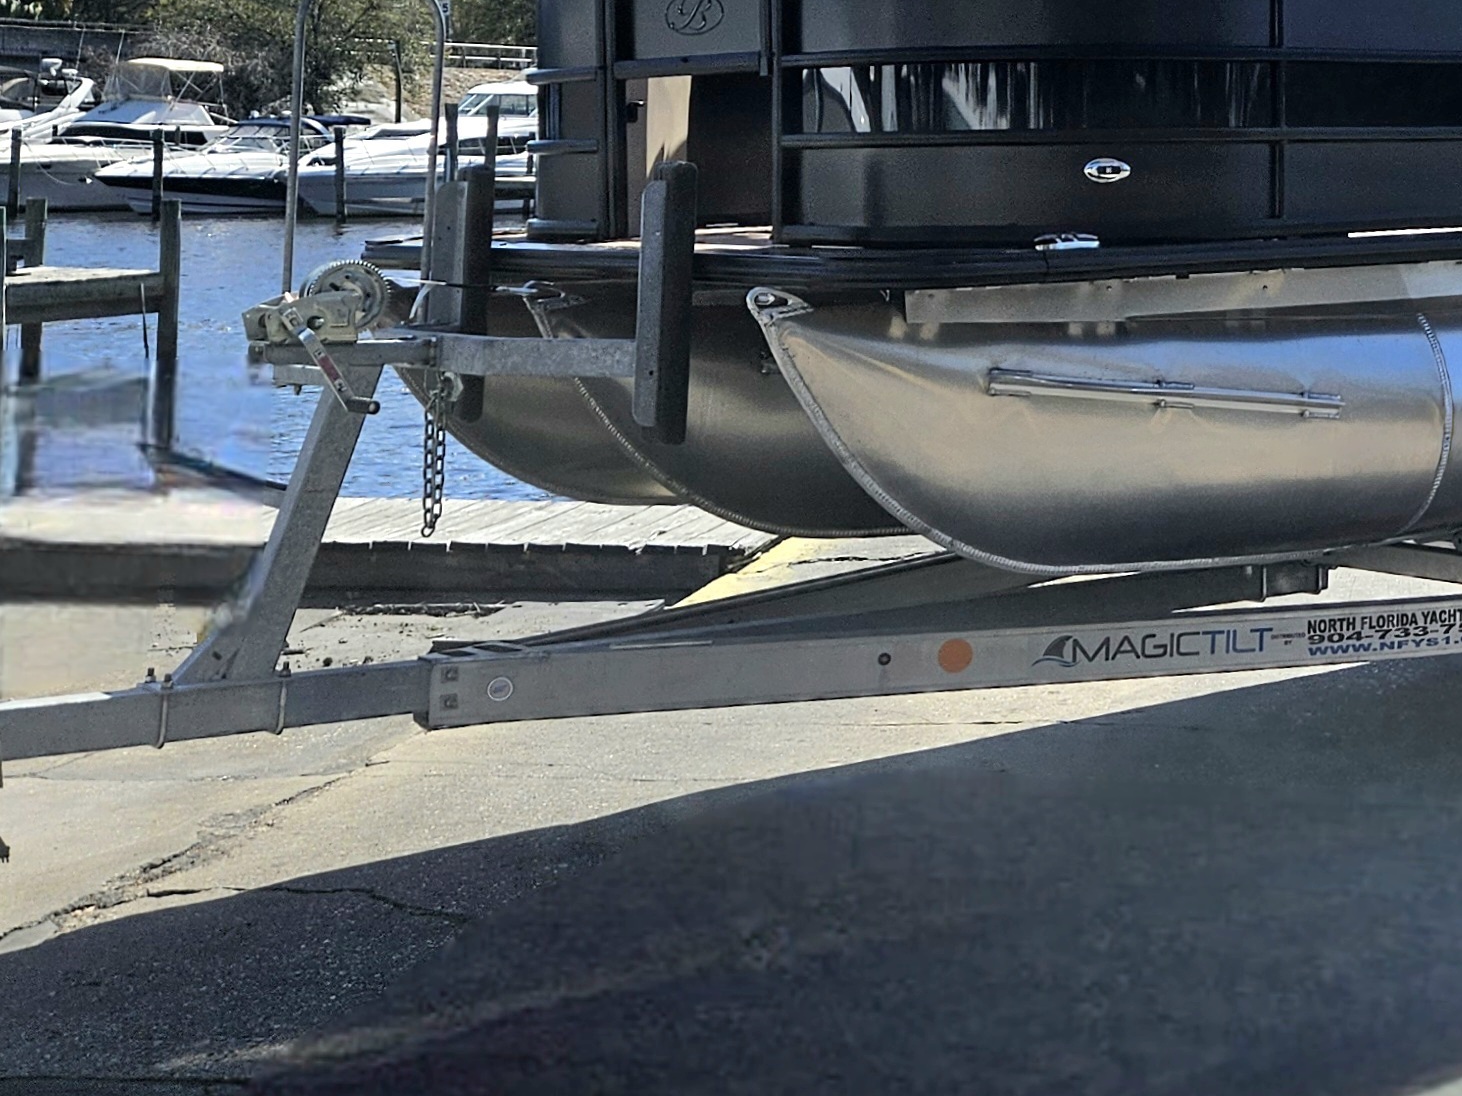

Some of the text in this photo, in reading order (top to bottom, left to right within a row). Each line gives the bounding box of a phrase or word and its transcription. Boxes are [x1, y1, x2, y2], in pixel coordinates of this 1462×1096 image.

[1307, 616, 1356, 635] NORTH
[1361, 612, 1418, 631] FLORIDA
[1072, 627, 1274, 663] MAGICTILT
